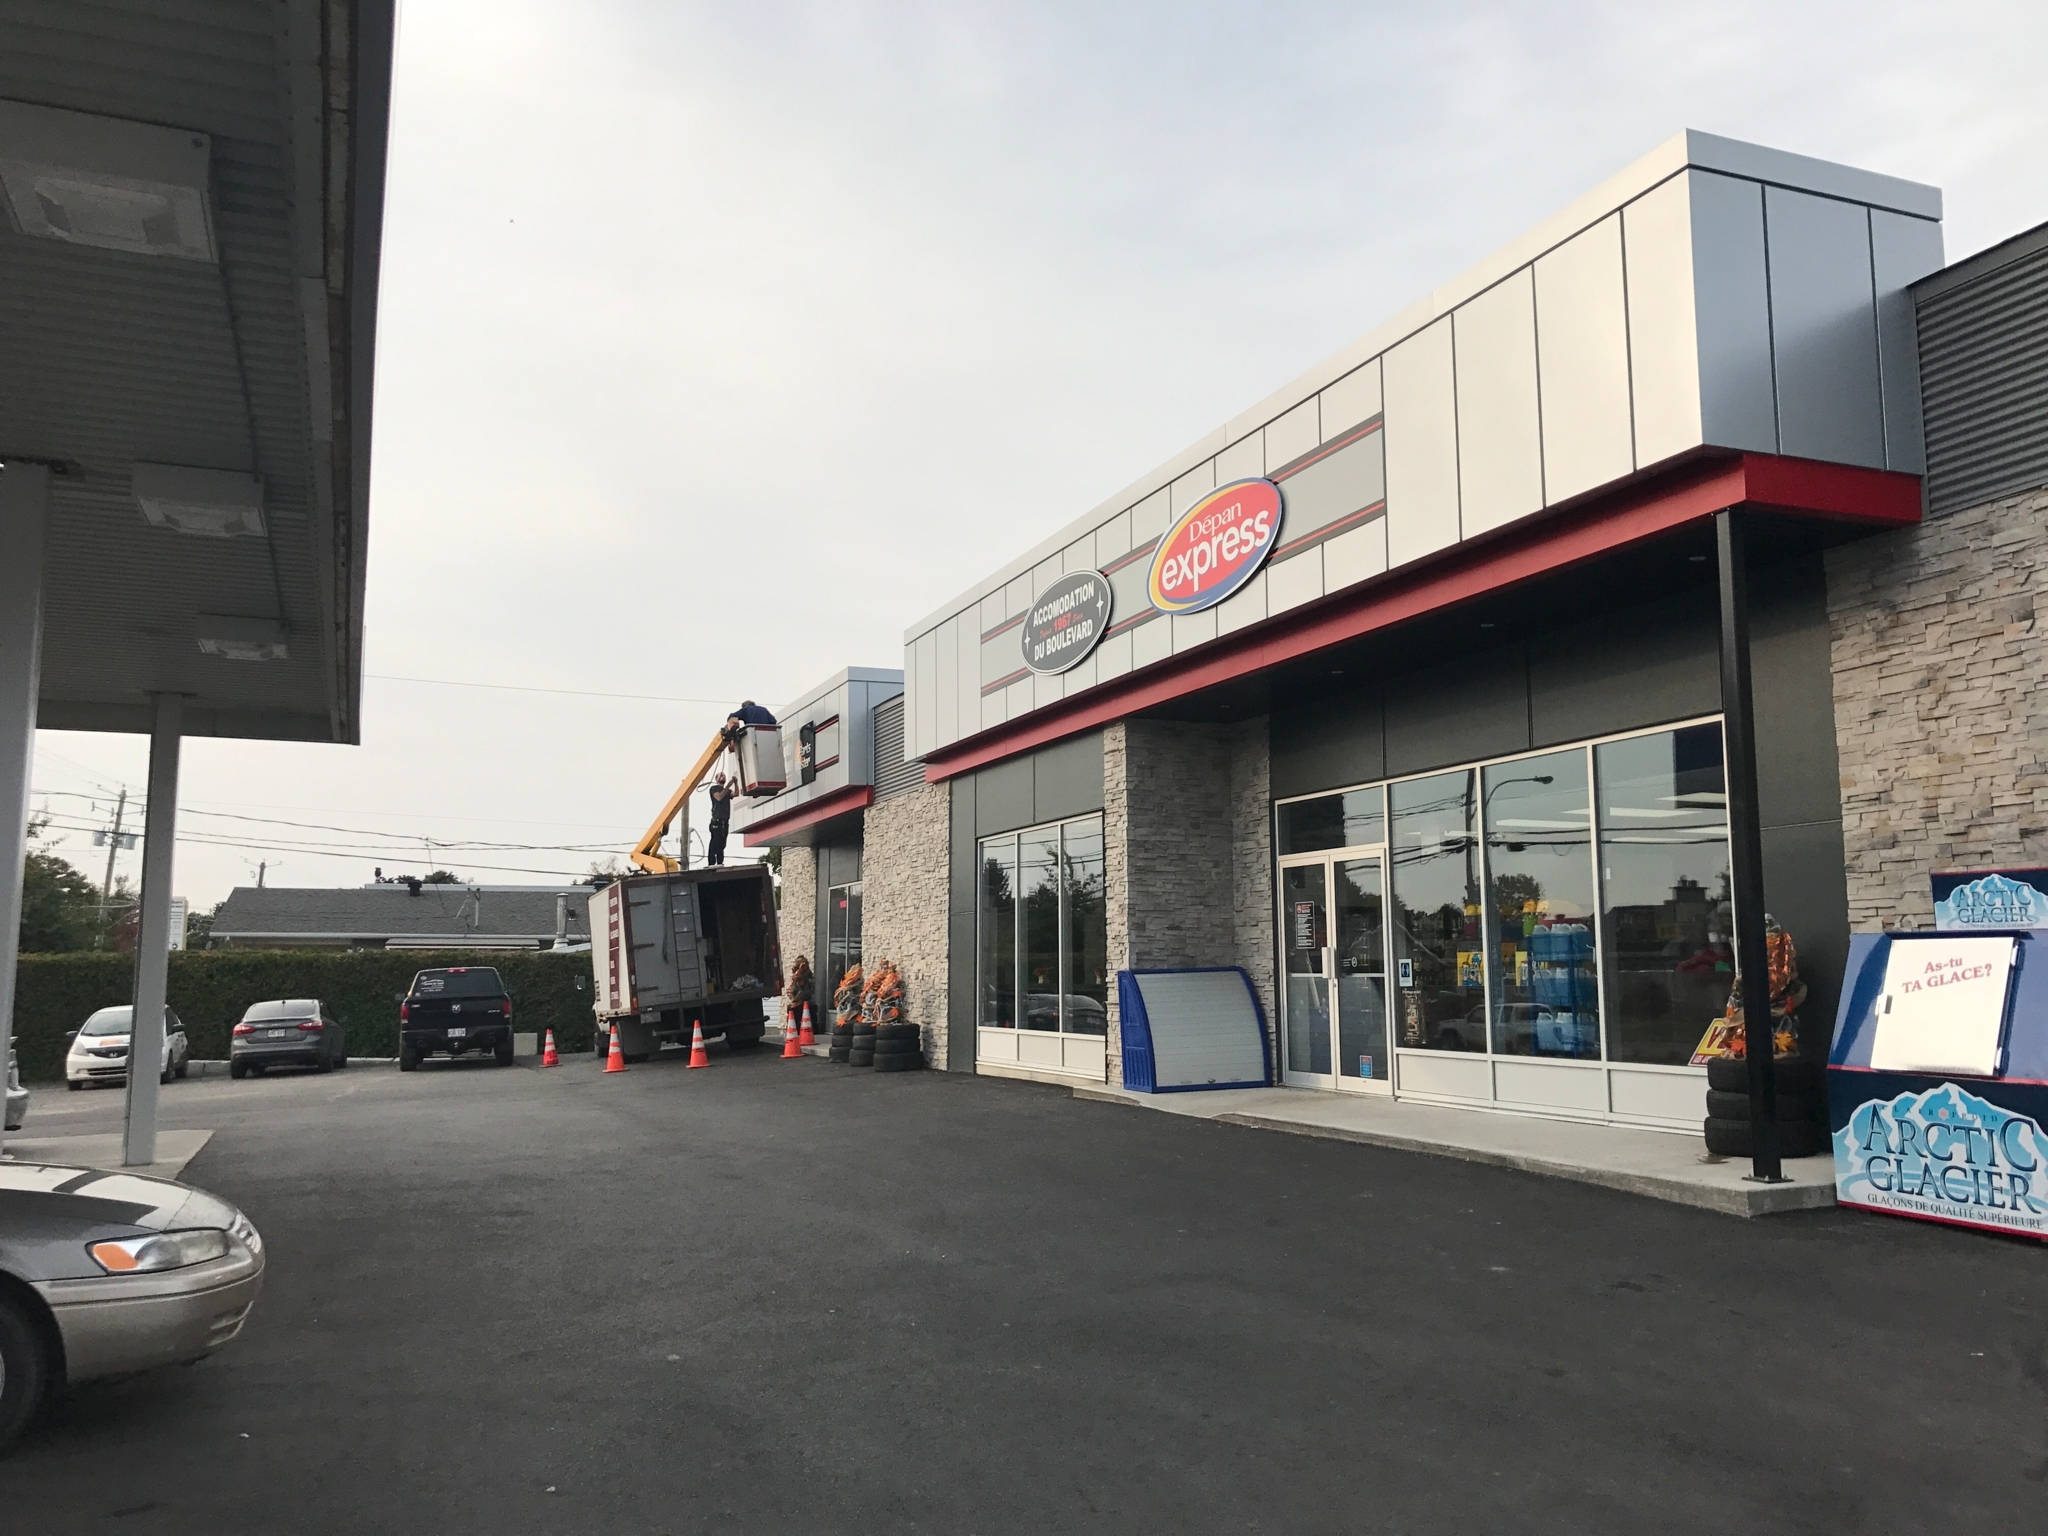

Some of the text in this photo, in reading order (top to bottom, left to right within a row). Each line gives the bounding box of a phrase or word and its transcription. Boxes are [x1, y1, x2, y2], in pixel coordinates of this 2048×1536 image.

[1189, 502, 1242, 543] Dépan
[1162, 510, 1270, 592] express
[1033, 580, 1094, 627] ACCOMODATION
[1053, 612, 1072, 632] 1967
[1034, 619, 1093, 661] DU BOULEVARD
[1956, 884, 2031, 907] ARCTIC
[1958, 907, 2033, 923] GLACIER
[1901, 963, 1992, 993] TA GLACE?
[1924, 957, 1963, 974] As-tu
[1863, 1104, 2037, 1172] ARCTIC
[1865, 1155, 2042, 1214] GLACIER
[1867, 1193, 2045, 1230] GLAÇONS DE QUALITÉ SUPÉRIEURE
